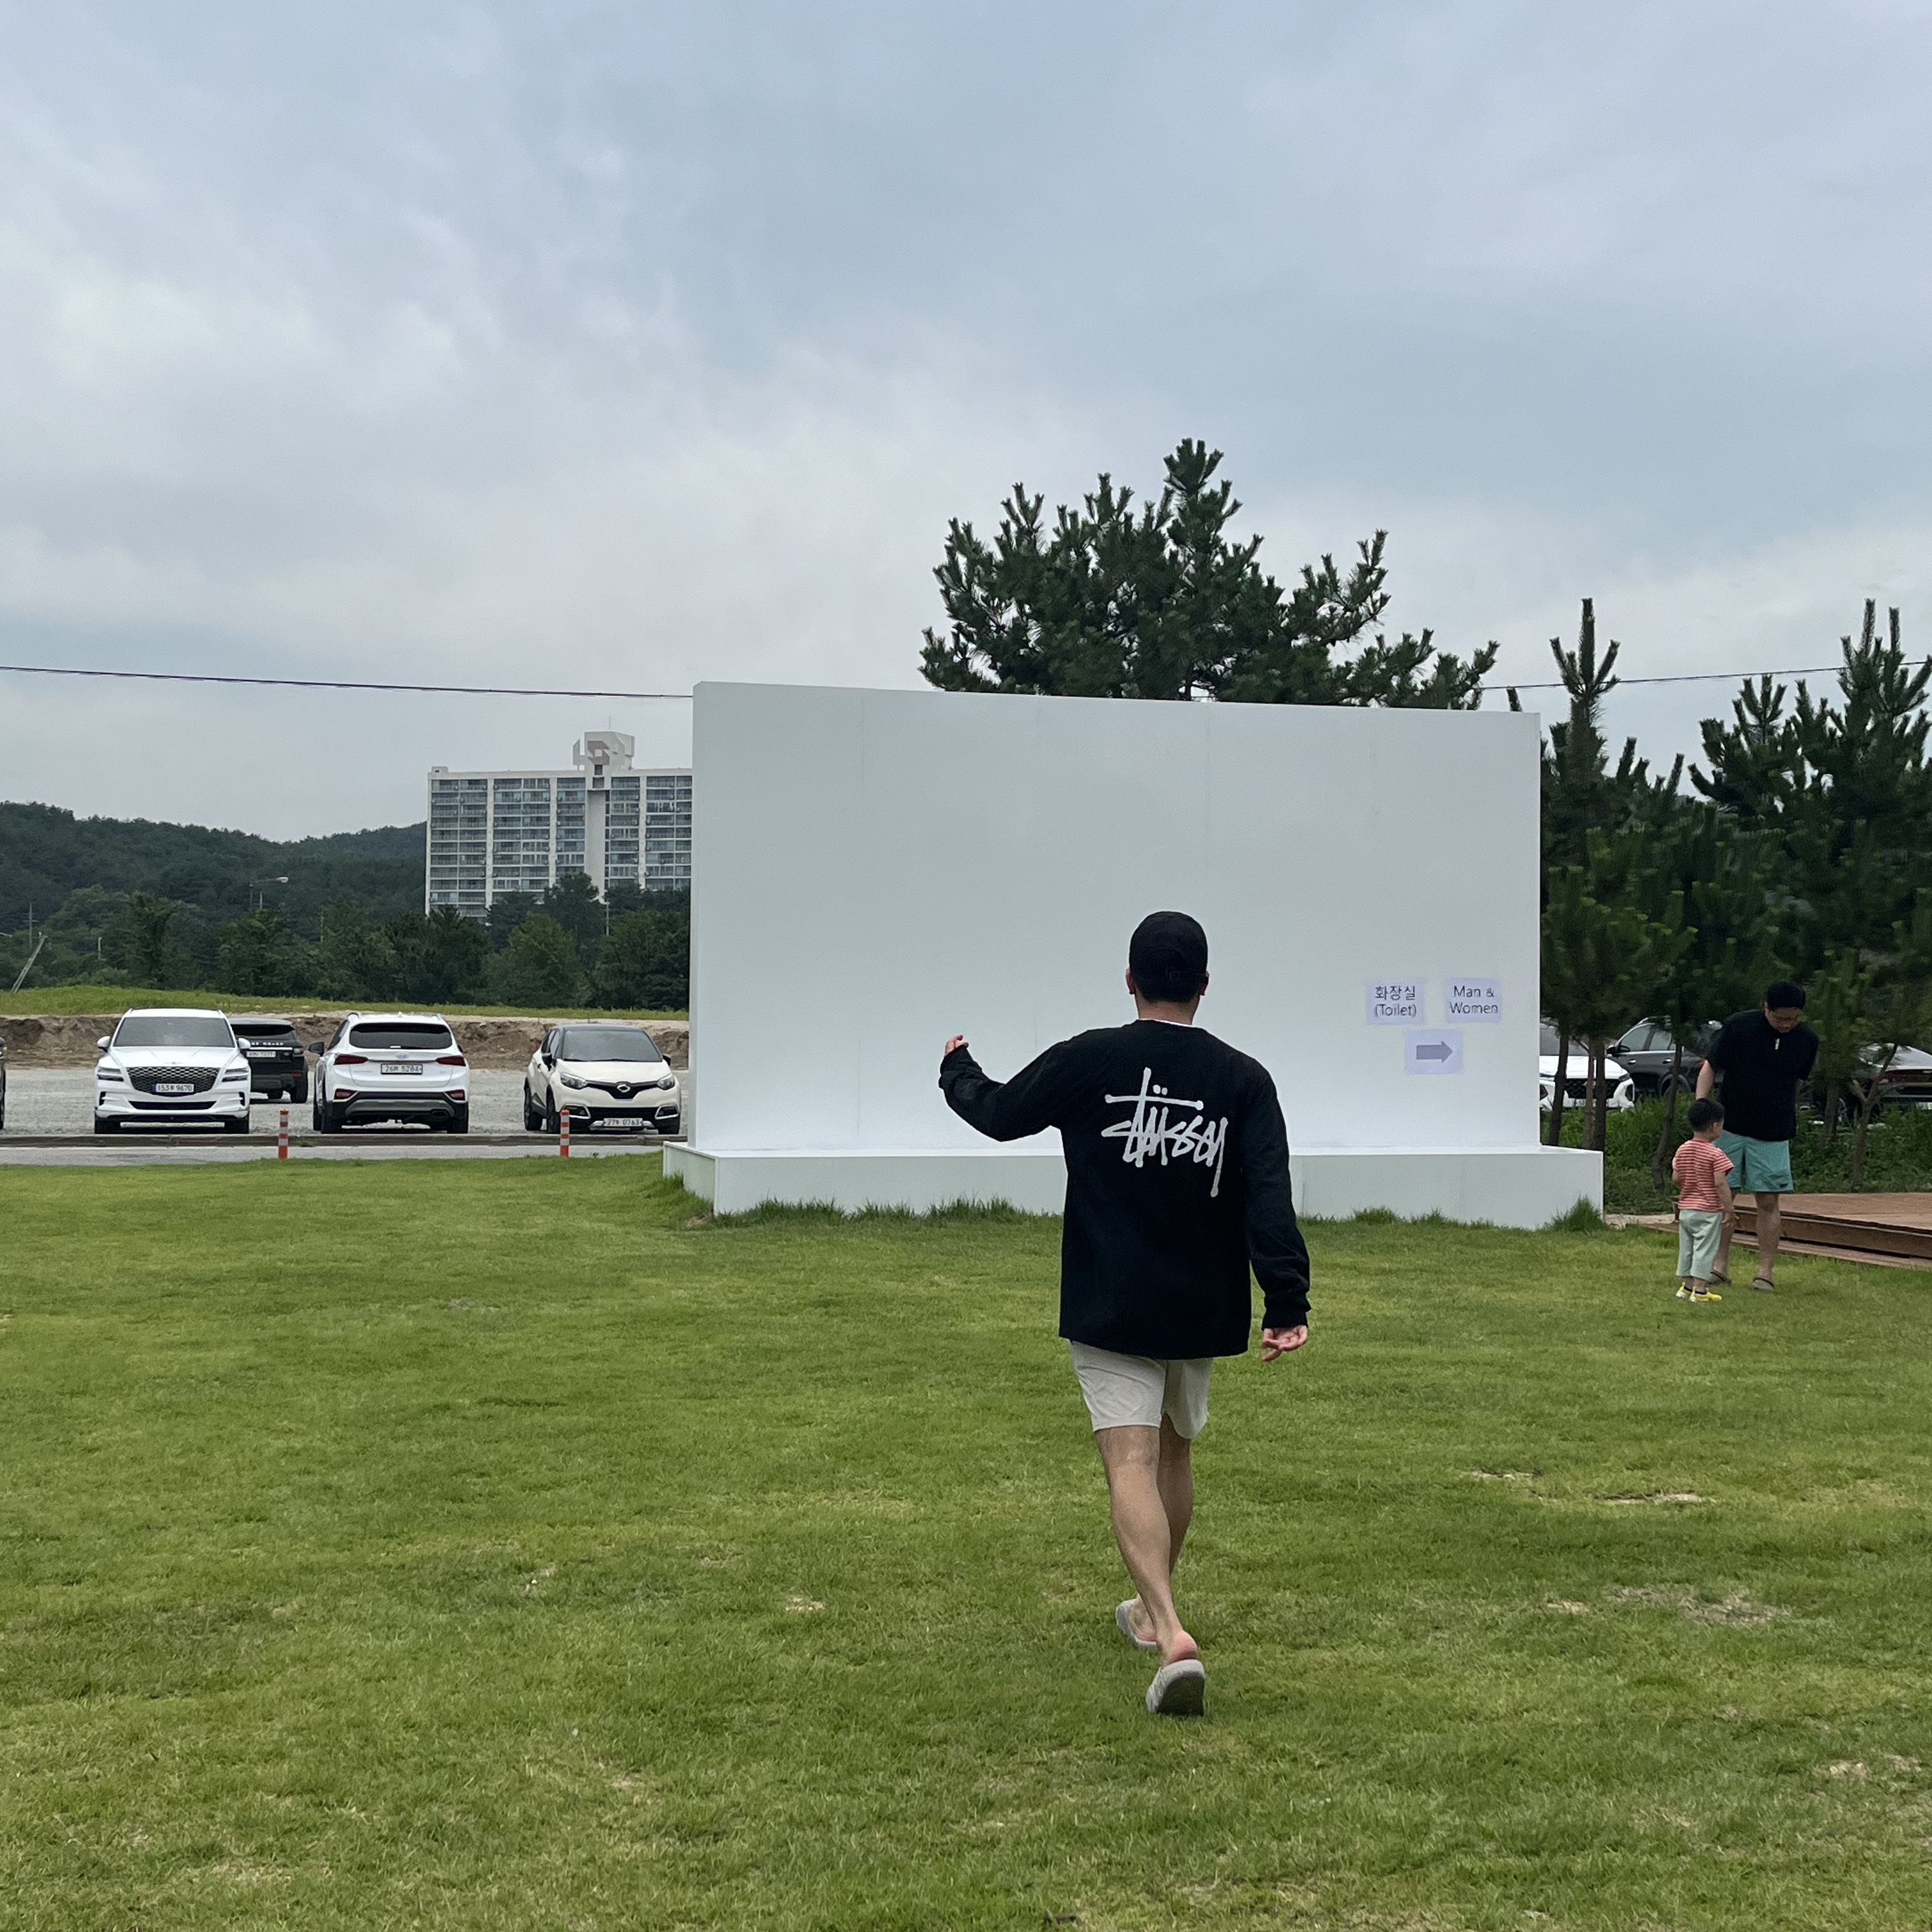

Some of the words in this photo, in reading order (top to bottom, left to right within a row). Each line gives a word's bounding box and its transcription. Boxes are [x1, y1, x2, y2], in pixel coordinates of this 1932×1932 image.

[1375, 985, 1416, 1000] 화장실
[1453, 985, 1481, 997] Man
[1486, 988, 1495, 997] &
[1374, 1003, 1417, 1018] (Toilet)
[1448, 1002, 1498, 1014] Women
